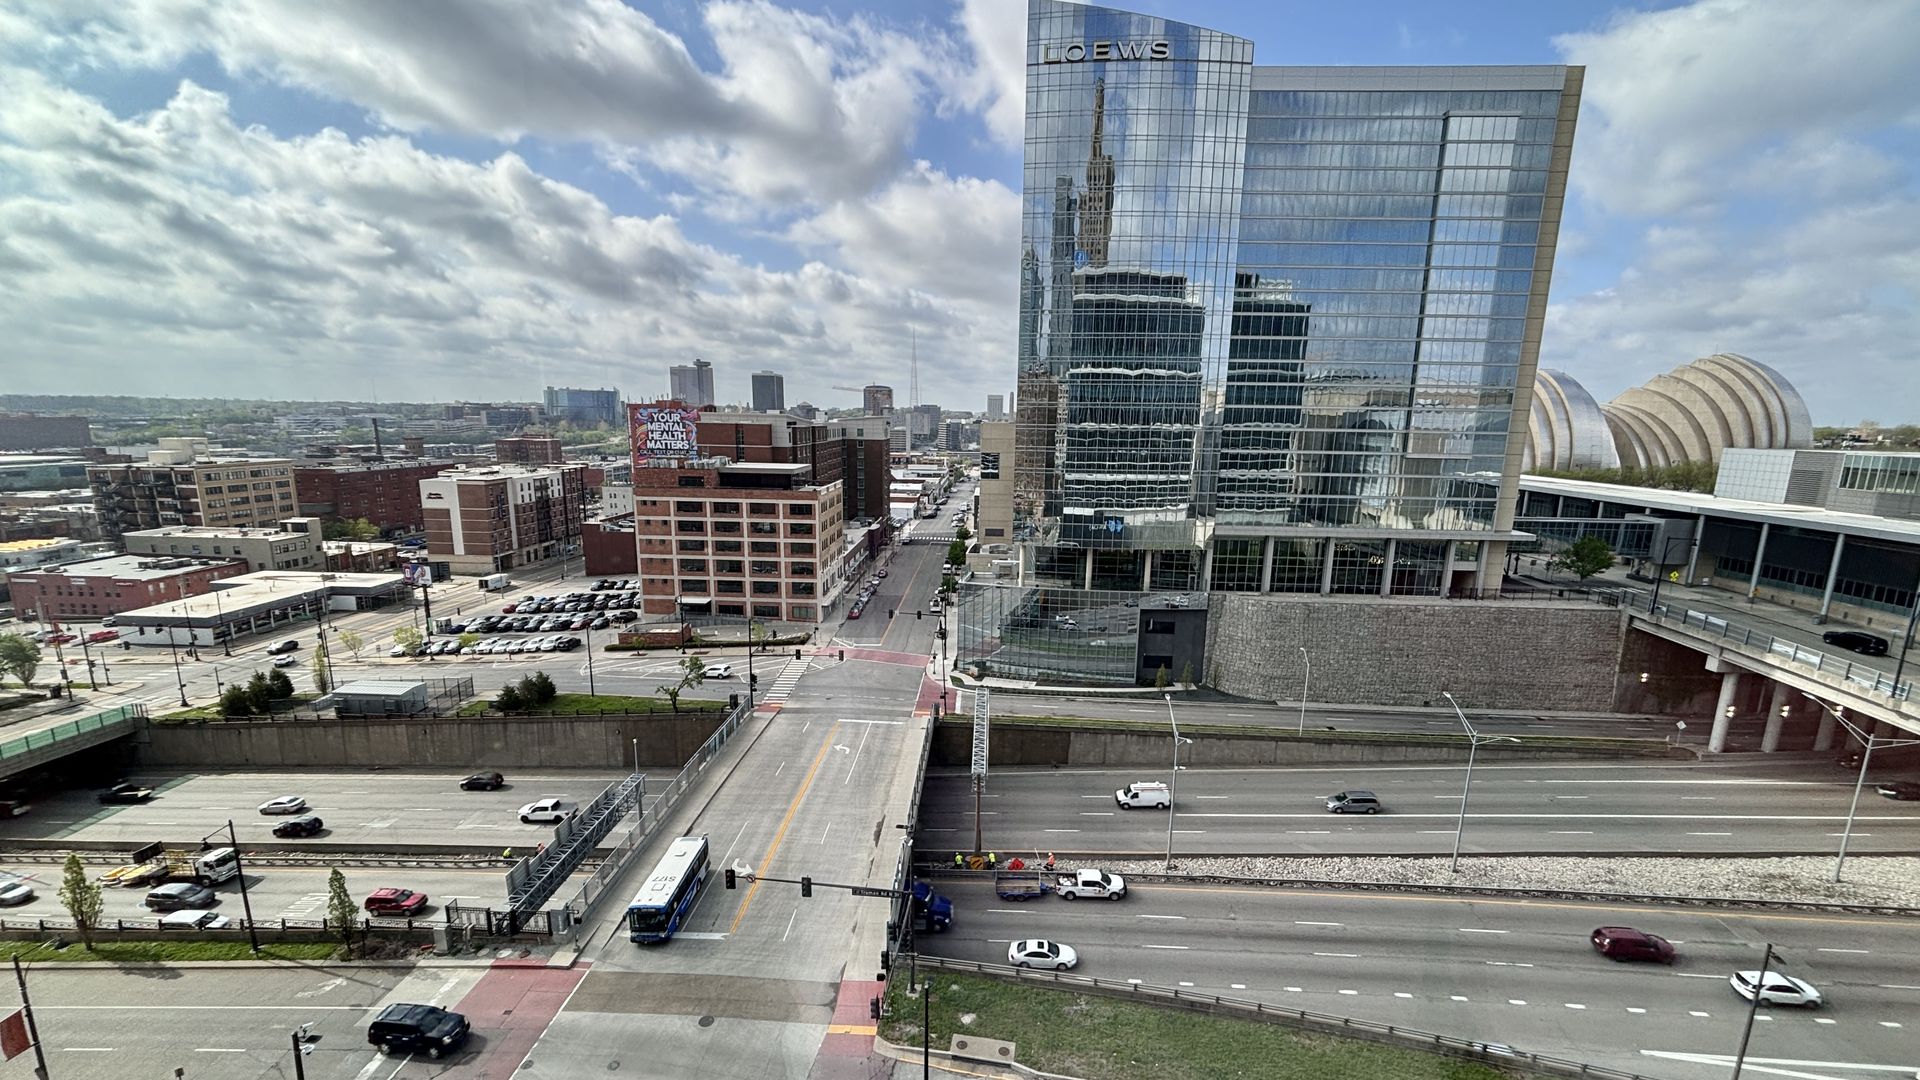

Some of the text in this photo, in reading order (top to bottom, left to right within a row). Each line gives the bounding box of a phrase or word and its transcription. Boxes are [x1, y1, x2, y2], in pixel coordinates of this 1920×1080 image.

[1043, 40, 1170, 63] LOEWS
[652, 412, 681, 422] YOUR
[647, 422, 686, 431] MENTAL
[648, 431, 687, 440] HEALTH
[646, 440, 690, 450] MATTERS
